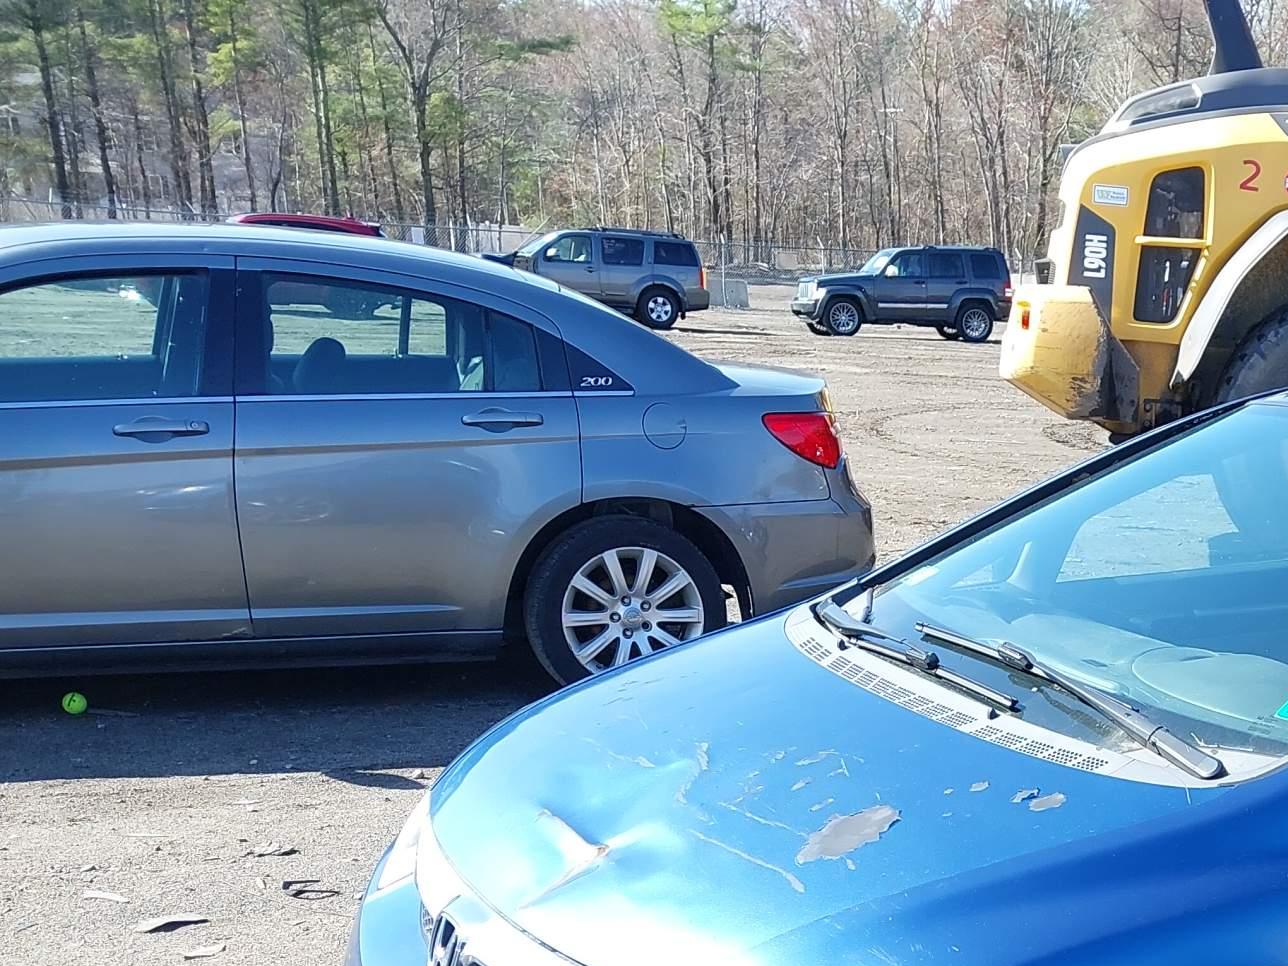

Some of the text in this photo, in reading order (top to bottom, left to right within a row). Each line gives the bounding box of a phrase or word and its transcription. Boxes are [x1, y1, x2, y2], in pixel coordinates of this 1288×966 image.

[1240, 159, 1261, 191] 2
[1083, 234, 1107, 278] L90H
[580, 376, 612, 387] 200
